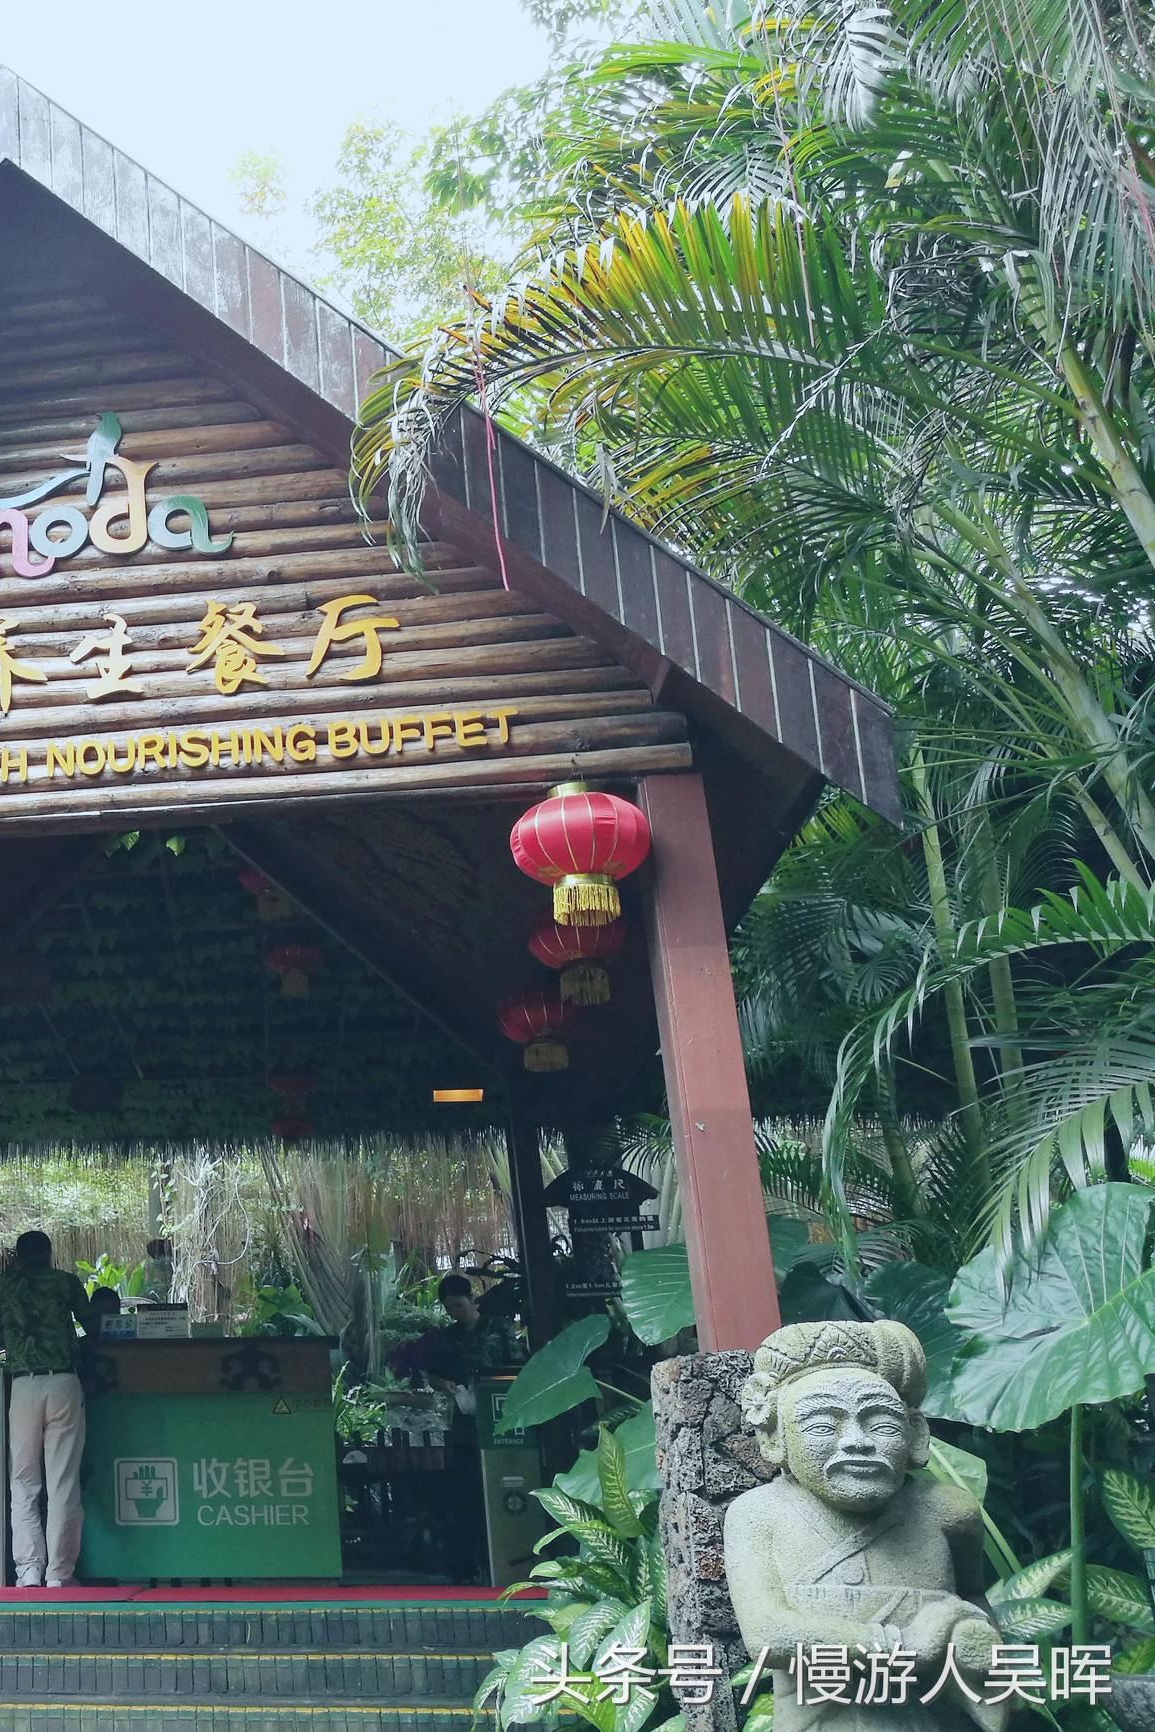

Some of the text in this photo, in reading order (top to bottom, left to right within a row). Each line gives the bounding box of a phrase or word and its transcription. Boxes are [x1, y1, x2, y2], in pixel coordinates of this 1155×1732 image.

[46, 721, 317, 778] NOURISHING
[328, 706, 519, 759] BUFFET
[570, 1192, 607, 1201] MEASURING
[192, 1457, 315, 1499] 收银台
[197, 1504, 310, 1526] CASHIER
